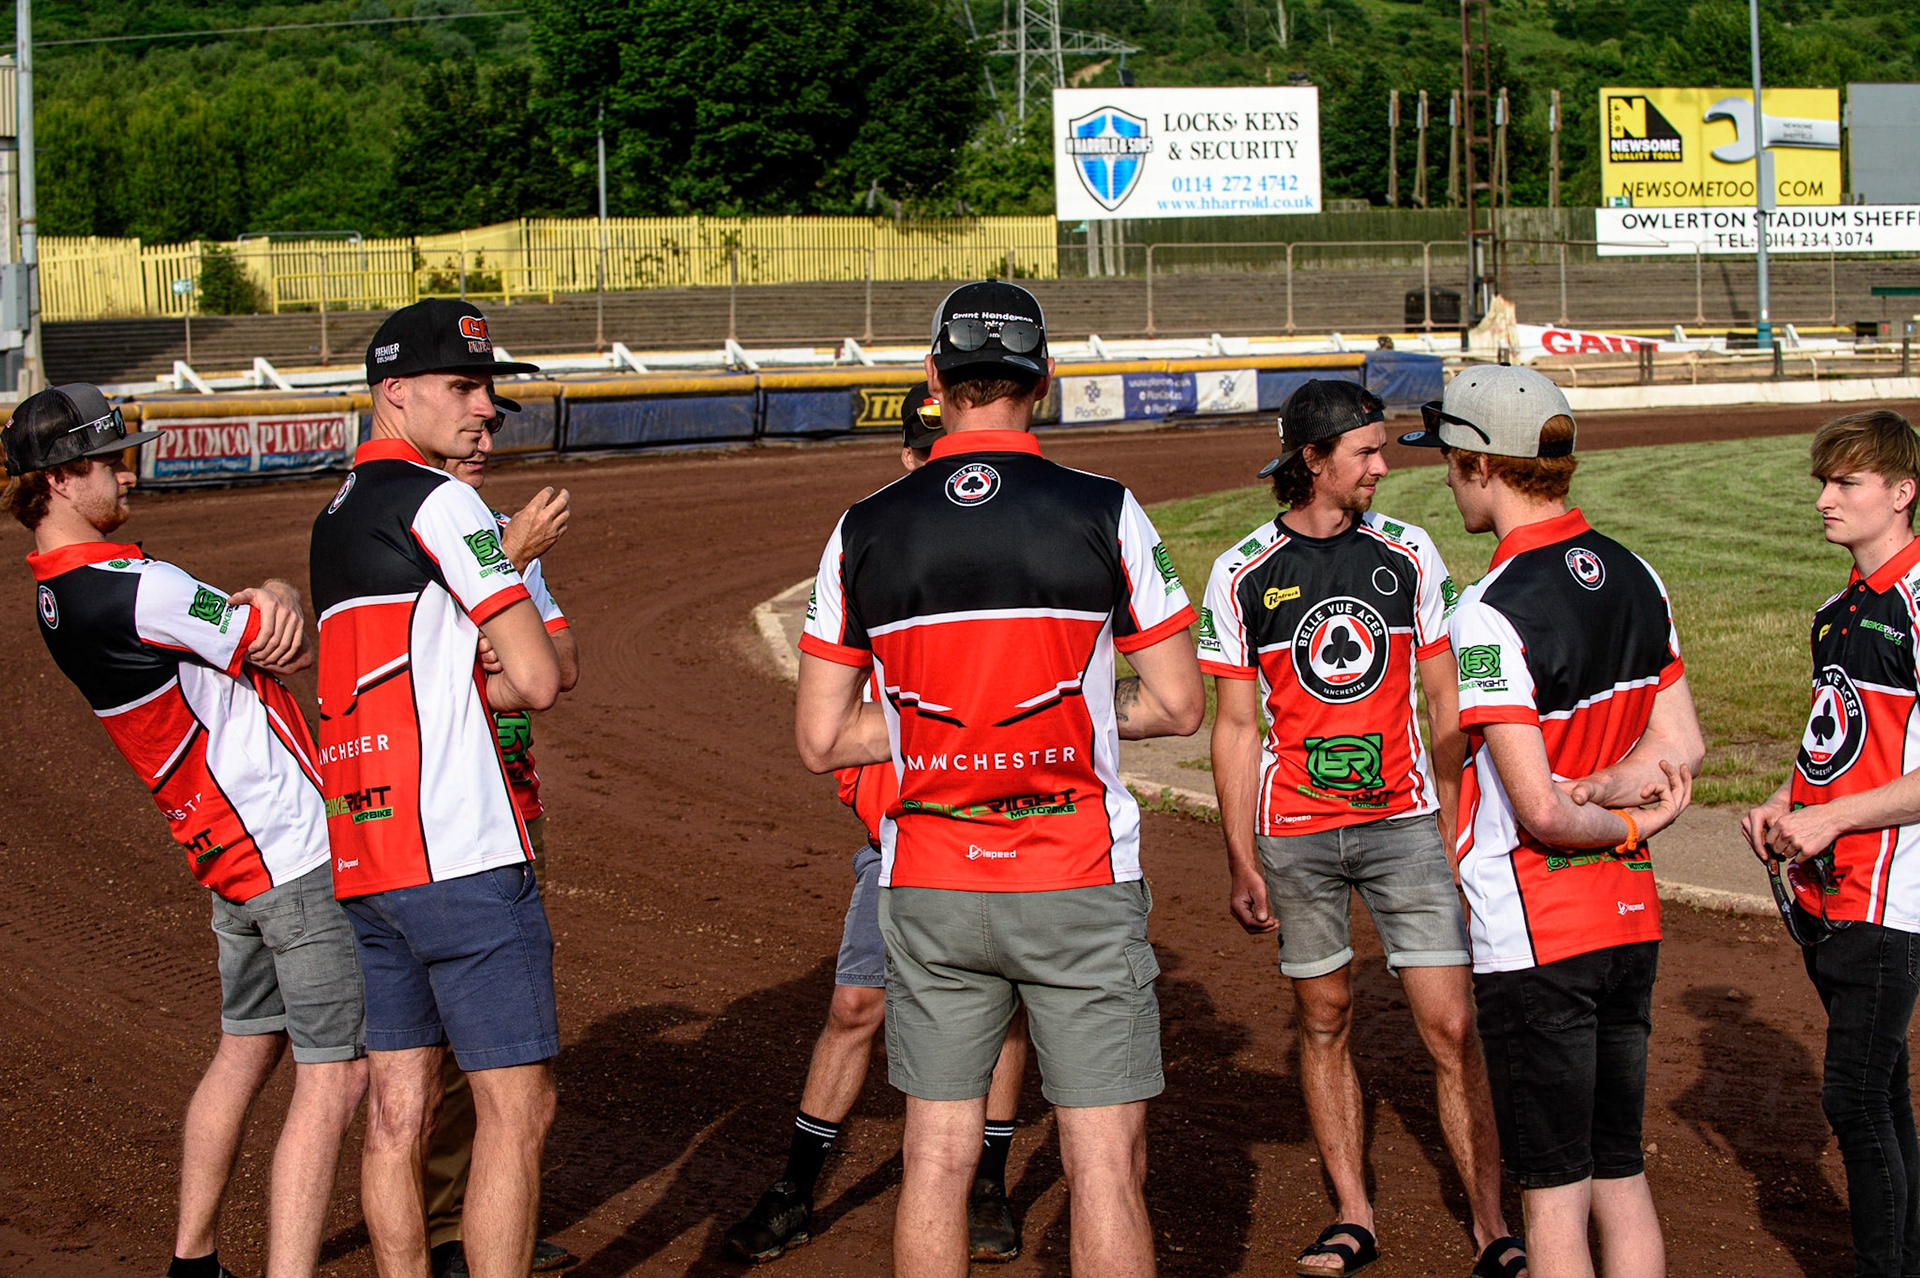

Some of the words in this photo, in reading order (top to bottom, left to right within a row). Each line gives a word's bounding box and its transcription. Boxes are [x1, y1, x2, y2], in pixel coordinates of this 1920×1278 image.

[1245, 111, 1299, 131] KEYS
[1168, 142, 1182, 160] &
[1190, 141, 1299, 160] SECURITY
[1611, 138, 1681, 153] NEWSOME
[1611, 152, 1650, 161] QUALITY
[1652, 152, 1681, 161] TOOLS
[1172, 176, 1212, 193] 0114
[1222, 175, 1252, 192] 272
[1257, 174, 1299, 192] 4742
[1157, 195, 1315, 212] www.hharrold.co.uk
[1622, 212, 1746, 230] OWLERTON
[1853, 210, 1920, 227] SHEFF
[1715, 233, 1755, 248] TEL:
[1765, 232, 1795, 247] 0114
[1800, 232, 1829, 247] 234
[1836, 231, 1874, 246] 3074
[1075, 405, 1112, 419] PlanCon
[157, 424, 250, 460] PLUMCO
[259, 420, 346, 455] PLUMCO
[1297, 610, 1326, 648] BELLE
[1327, 602, 1354, 615] VUE
[1356, 608, 1384, 638] ACES
